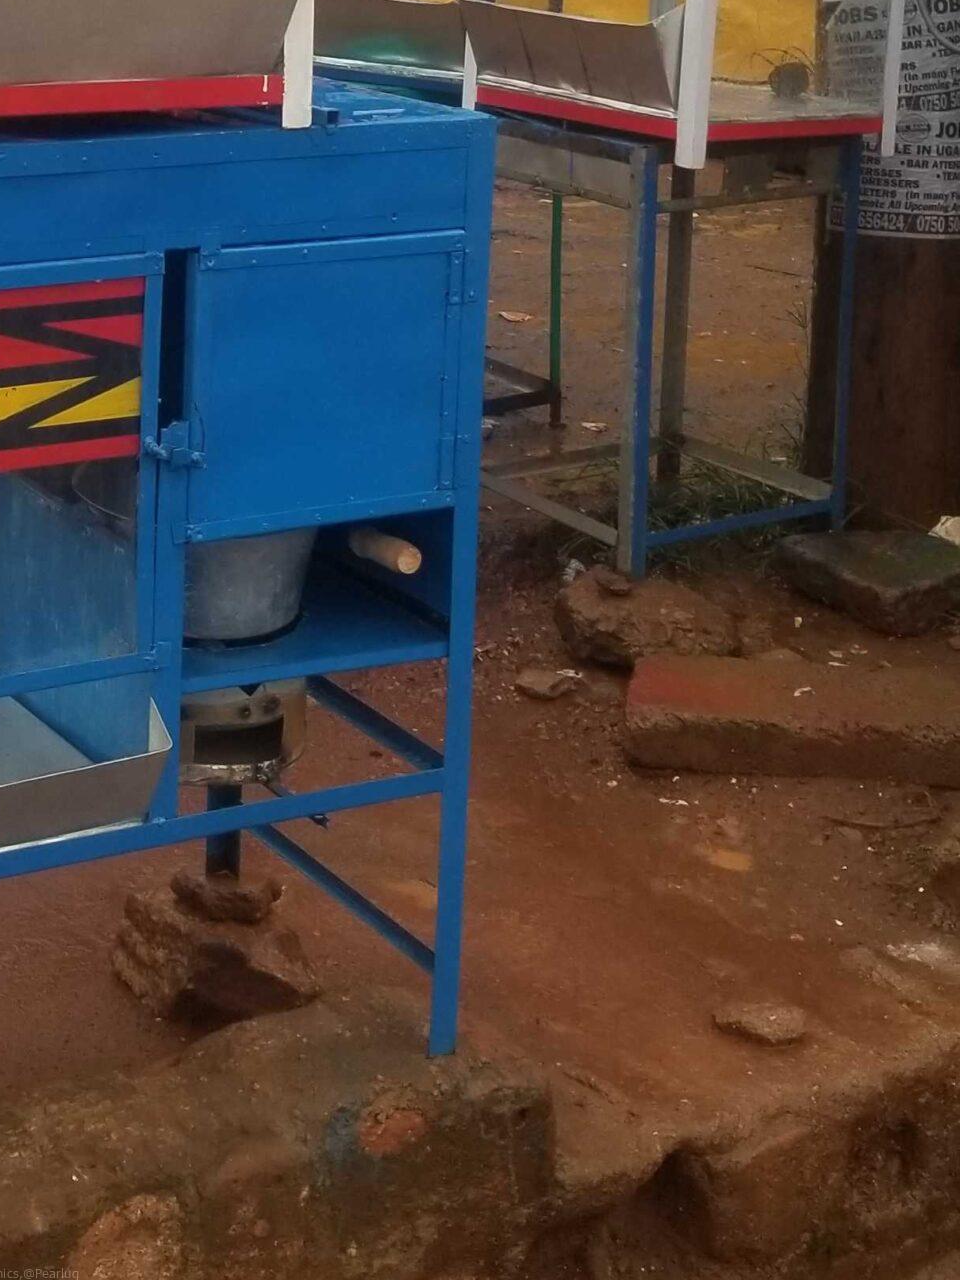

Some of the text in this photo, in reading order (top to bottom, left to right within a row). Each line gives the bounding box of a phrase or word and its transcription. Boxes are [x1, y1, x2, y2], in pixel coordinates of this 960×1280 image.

[907, 24, 921, 36] IN
[916, 145, 931, 155] IN
[906, 159, 929, 168] BAR
[916, 215, 945, 233] 0750
